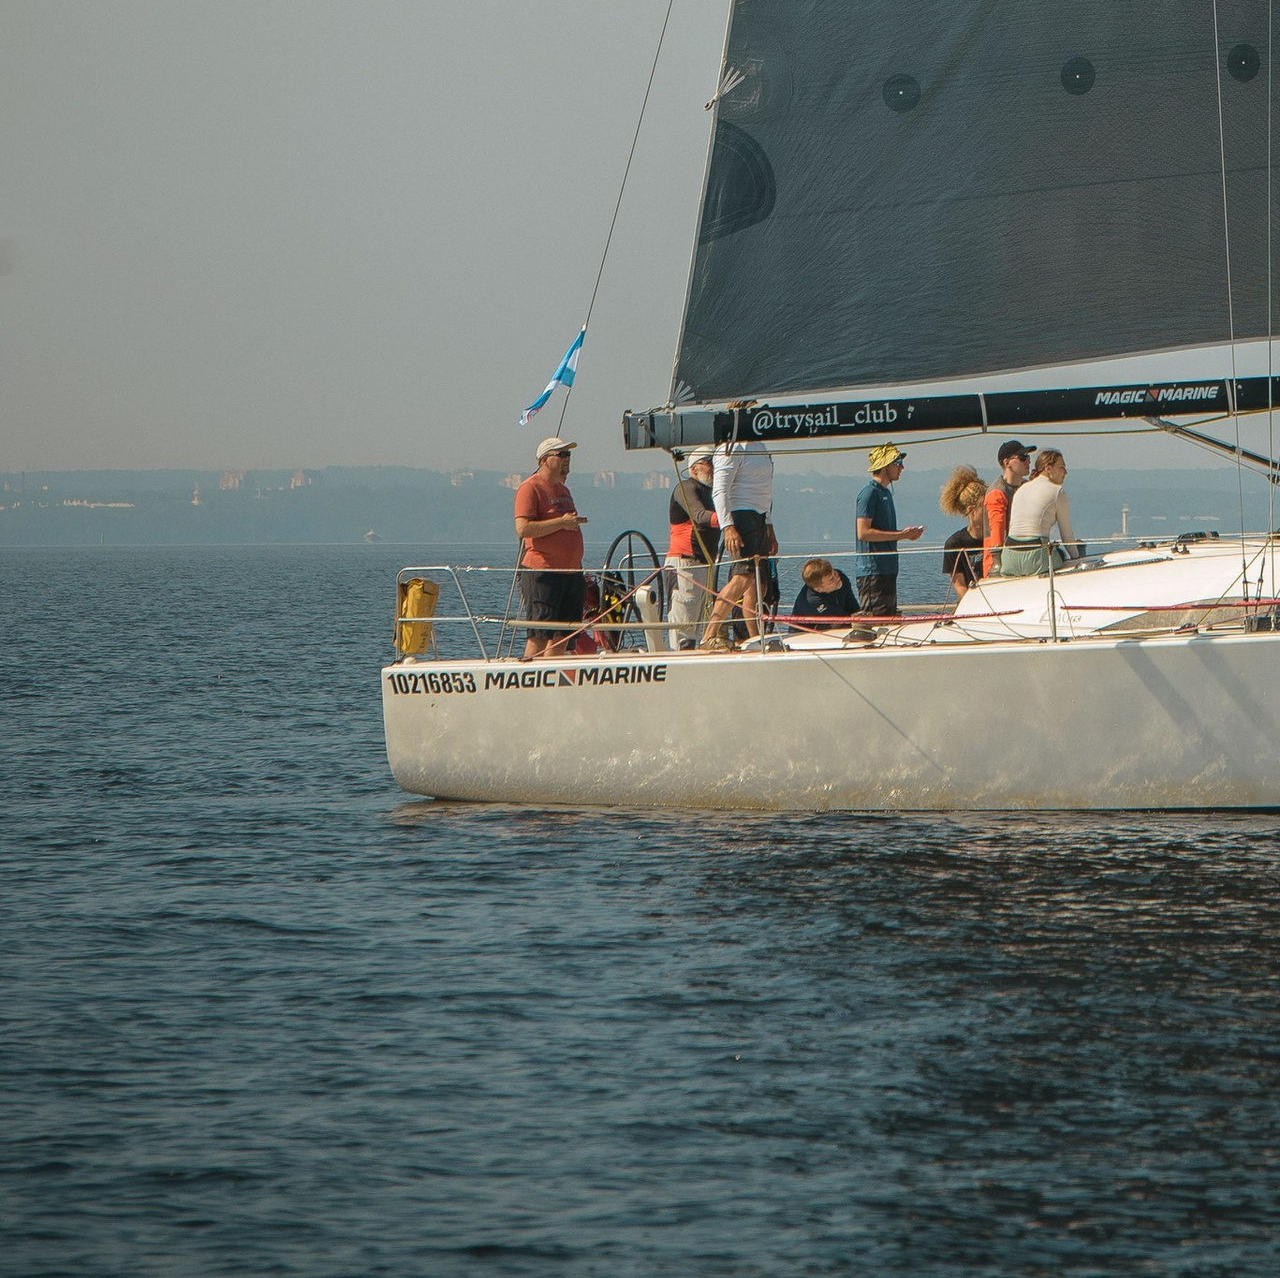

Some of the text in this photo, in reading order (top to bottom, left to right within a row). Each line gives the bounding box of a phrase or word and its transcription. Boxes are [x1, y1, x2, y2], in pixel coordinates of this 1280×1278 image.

[1094, 385, 1220, 406] MAGIC MARINE
[752, 402, 898, 436] @trysail_club
[386, 664, 669, 695] 10216853 MAGIC MARINE
